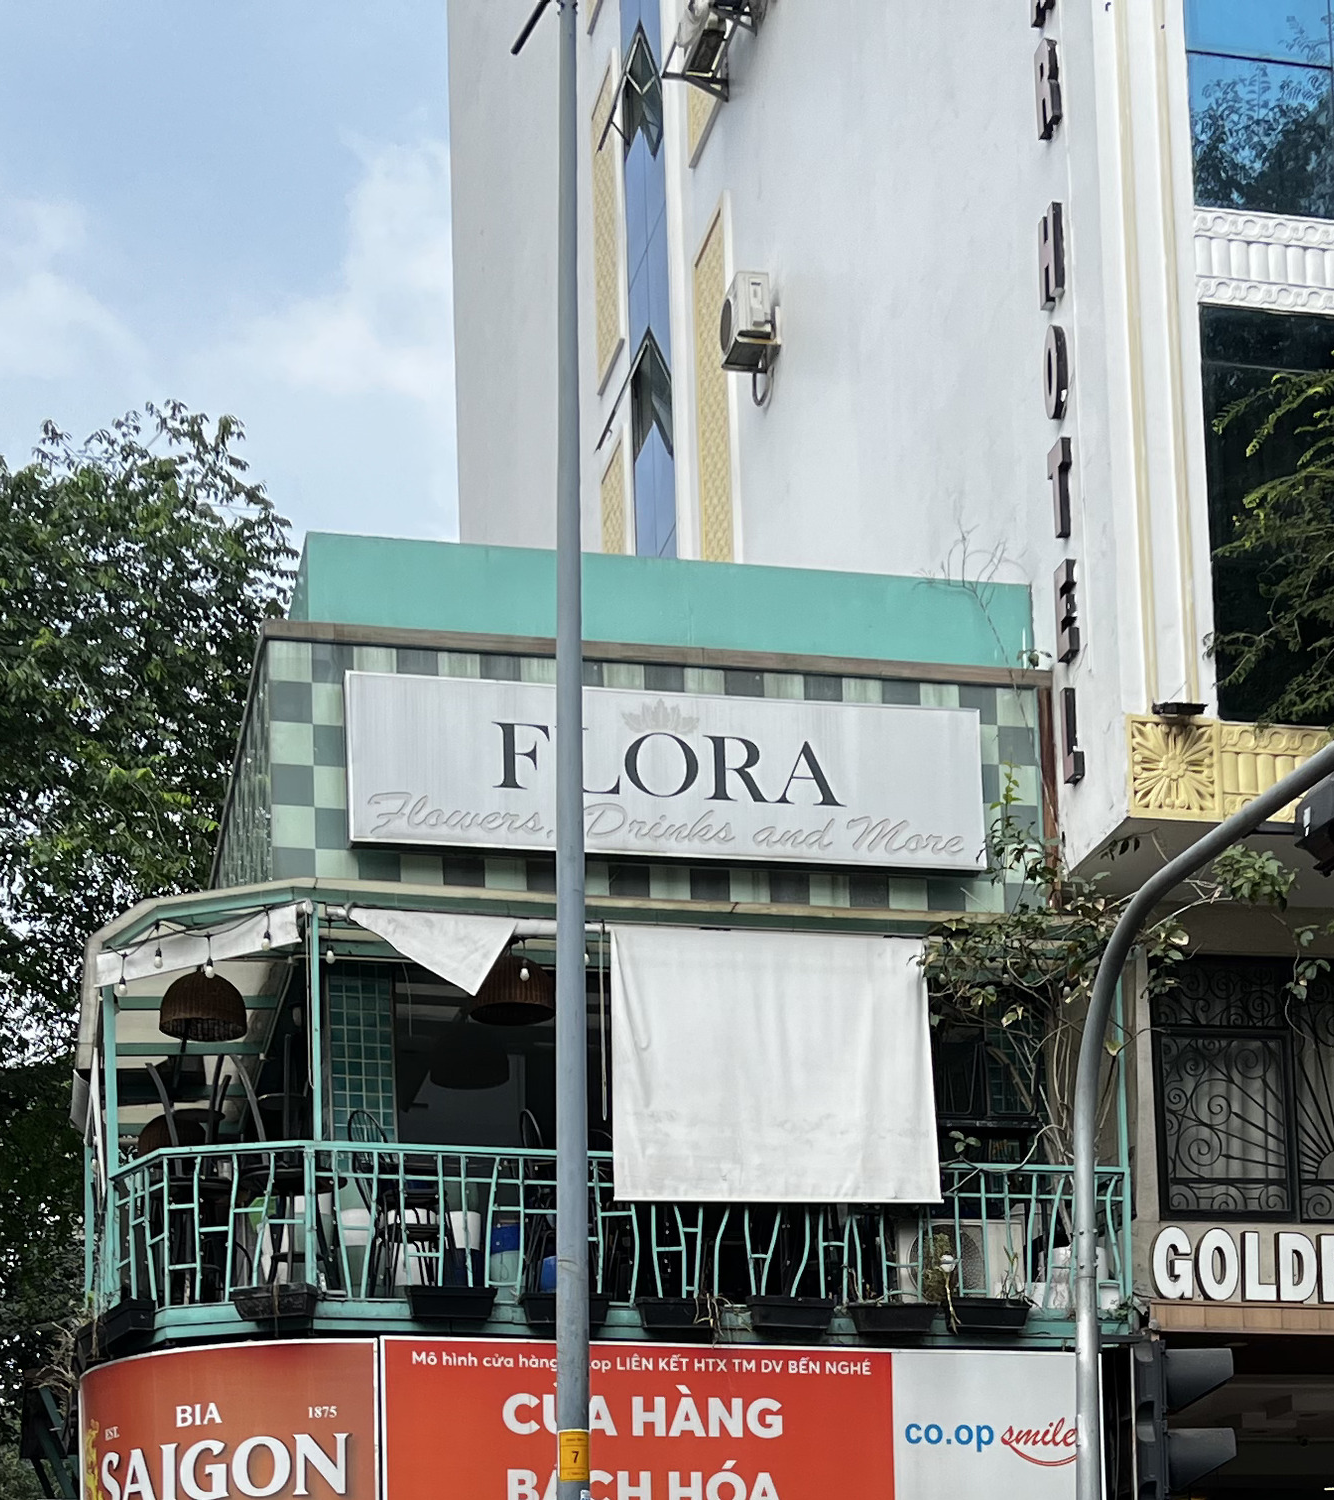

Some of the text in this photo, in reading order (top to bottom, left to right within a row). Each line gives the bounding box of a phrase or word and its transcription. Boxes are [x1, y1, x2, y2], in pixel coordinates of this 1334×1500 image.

[368, 790, 965, 858] Flowers, Drinks and More
[411, 1350, 873, 1376] Mô hình cửa hàng LIÊN KẾT HTX TM DV BẾN NGHÉ
[175, 1402, 223, 1428] BIA
[307, 1405, 338, 1419] 1875
[631, 1384, 784, 1439] HÀNG
[905, 1417, 1078, 1452] co.op smile
[571, 1450, 580, 1464] 7
